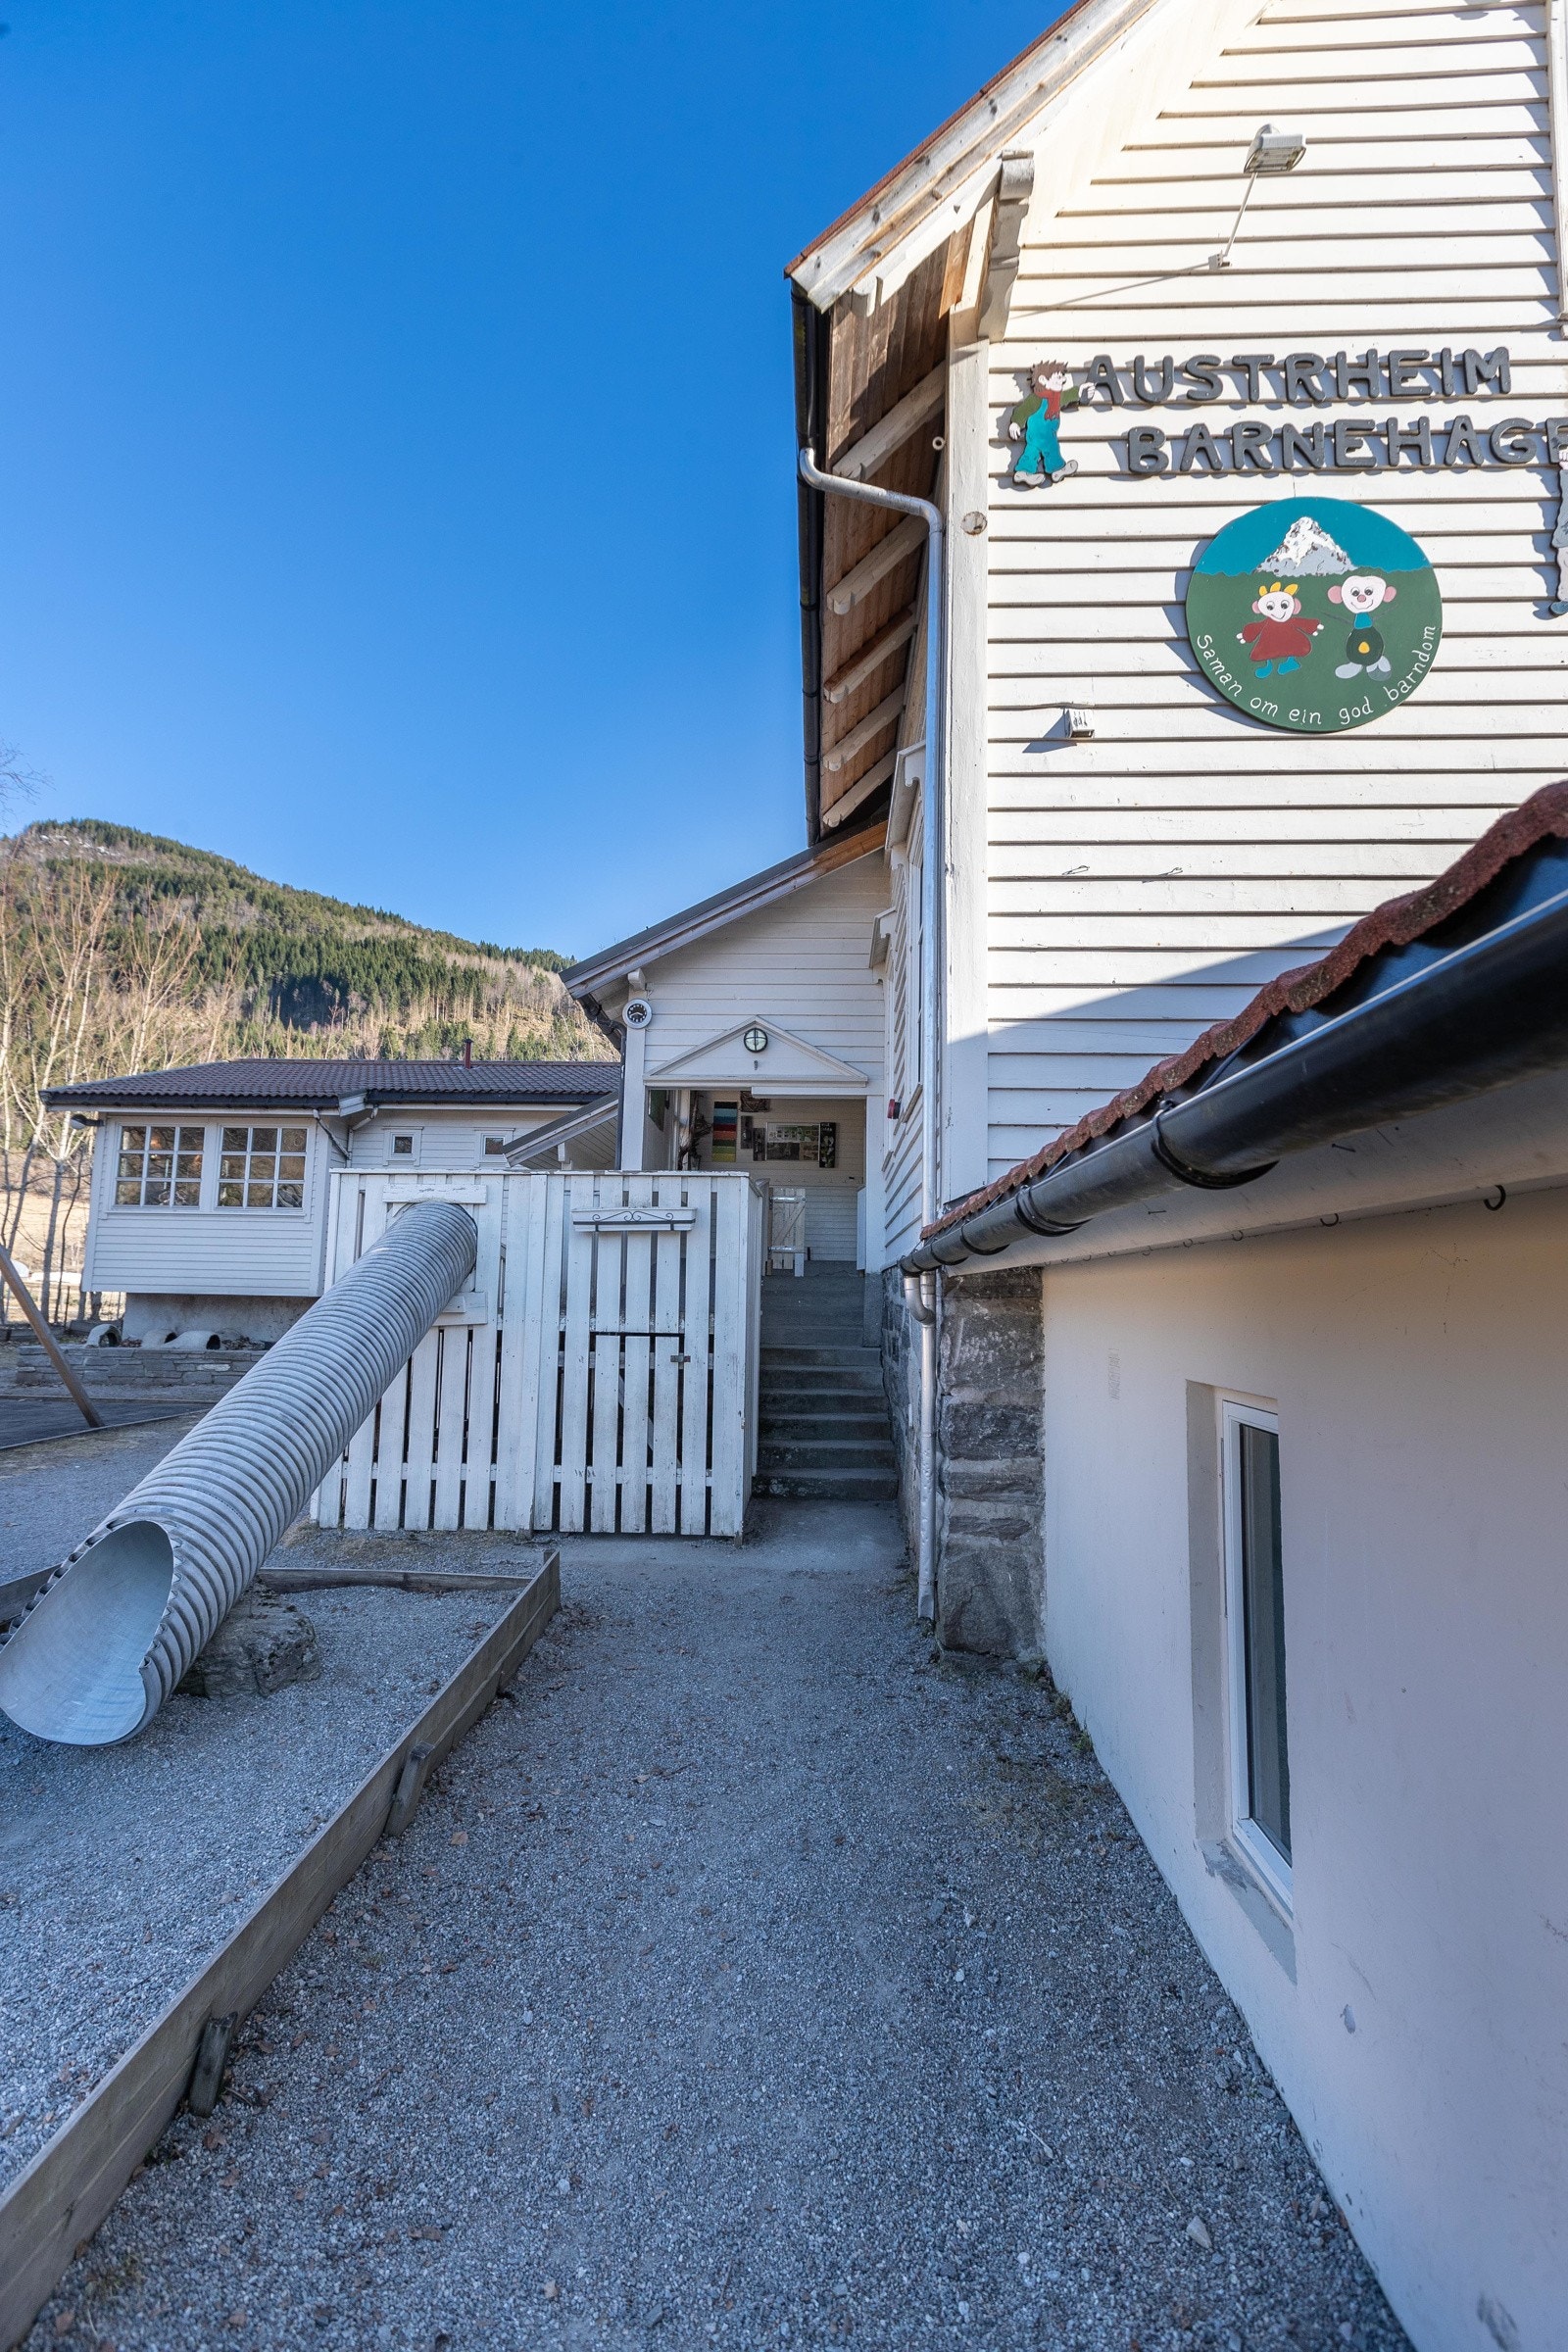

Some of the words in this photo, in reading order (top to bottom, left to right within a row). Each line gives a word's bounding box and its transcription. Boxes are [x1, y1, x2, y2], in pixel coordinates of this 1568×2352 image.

[1079, 346, 1512, 406] AUSTRHEIM
[1197, 633, 1245, 697] Saman
[1250, 697, 1279, 717] om
[1289, 709, 1322, 725] ein
[1339, 696, 1374, 725] god
[1383, 625, 1437, 702] barndom
